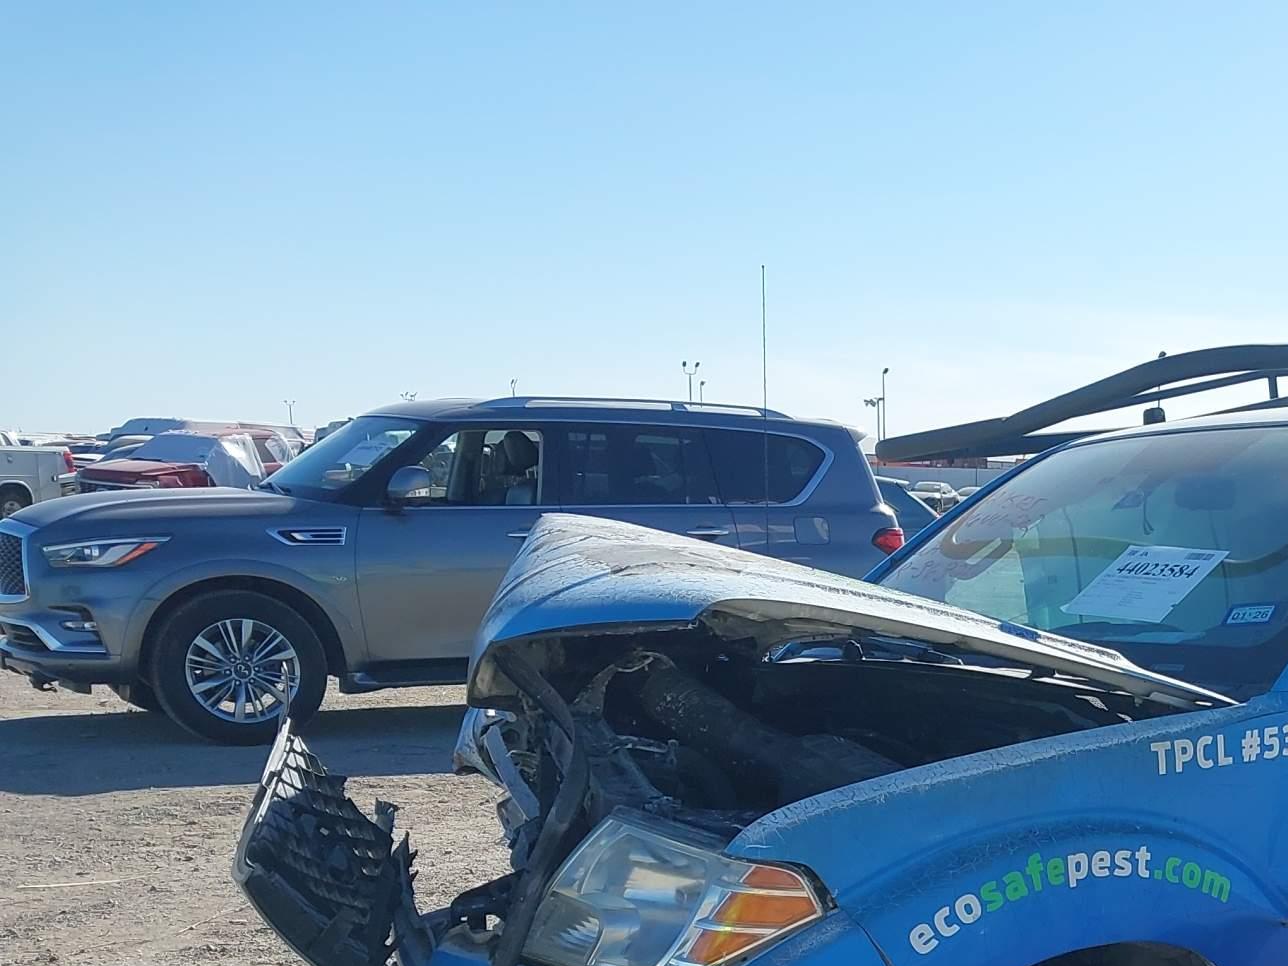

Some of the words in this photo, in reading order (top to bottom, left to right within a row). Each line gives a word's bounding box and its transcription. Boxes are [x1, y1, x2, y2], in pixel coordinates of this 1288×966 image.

[1116, 561, 1201, 579] 44023584
[1252, 610, 1269, 620] 26
[1150, 734, 1233, 775] TPCL
[909, 846, 1231, 954] ecosafepest.com
